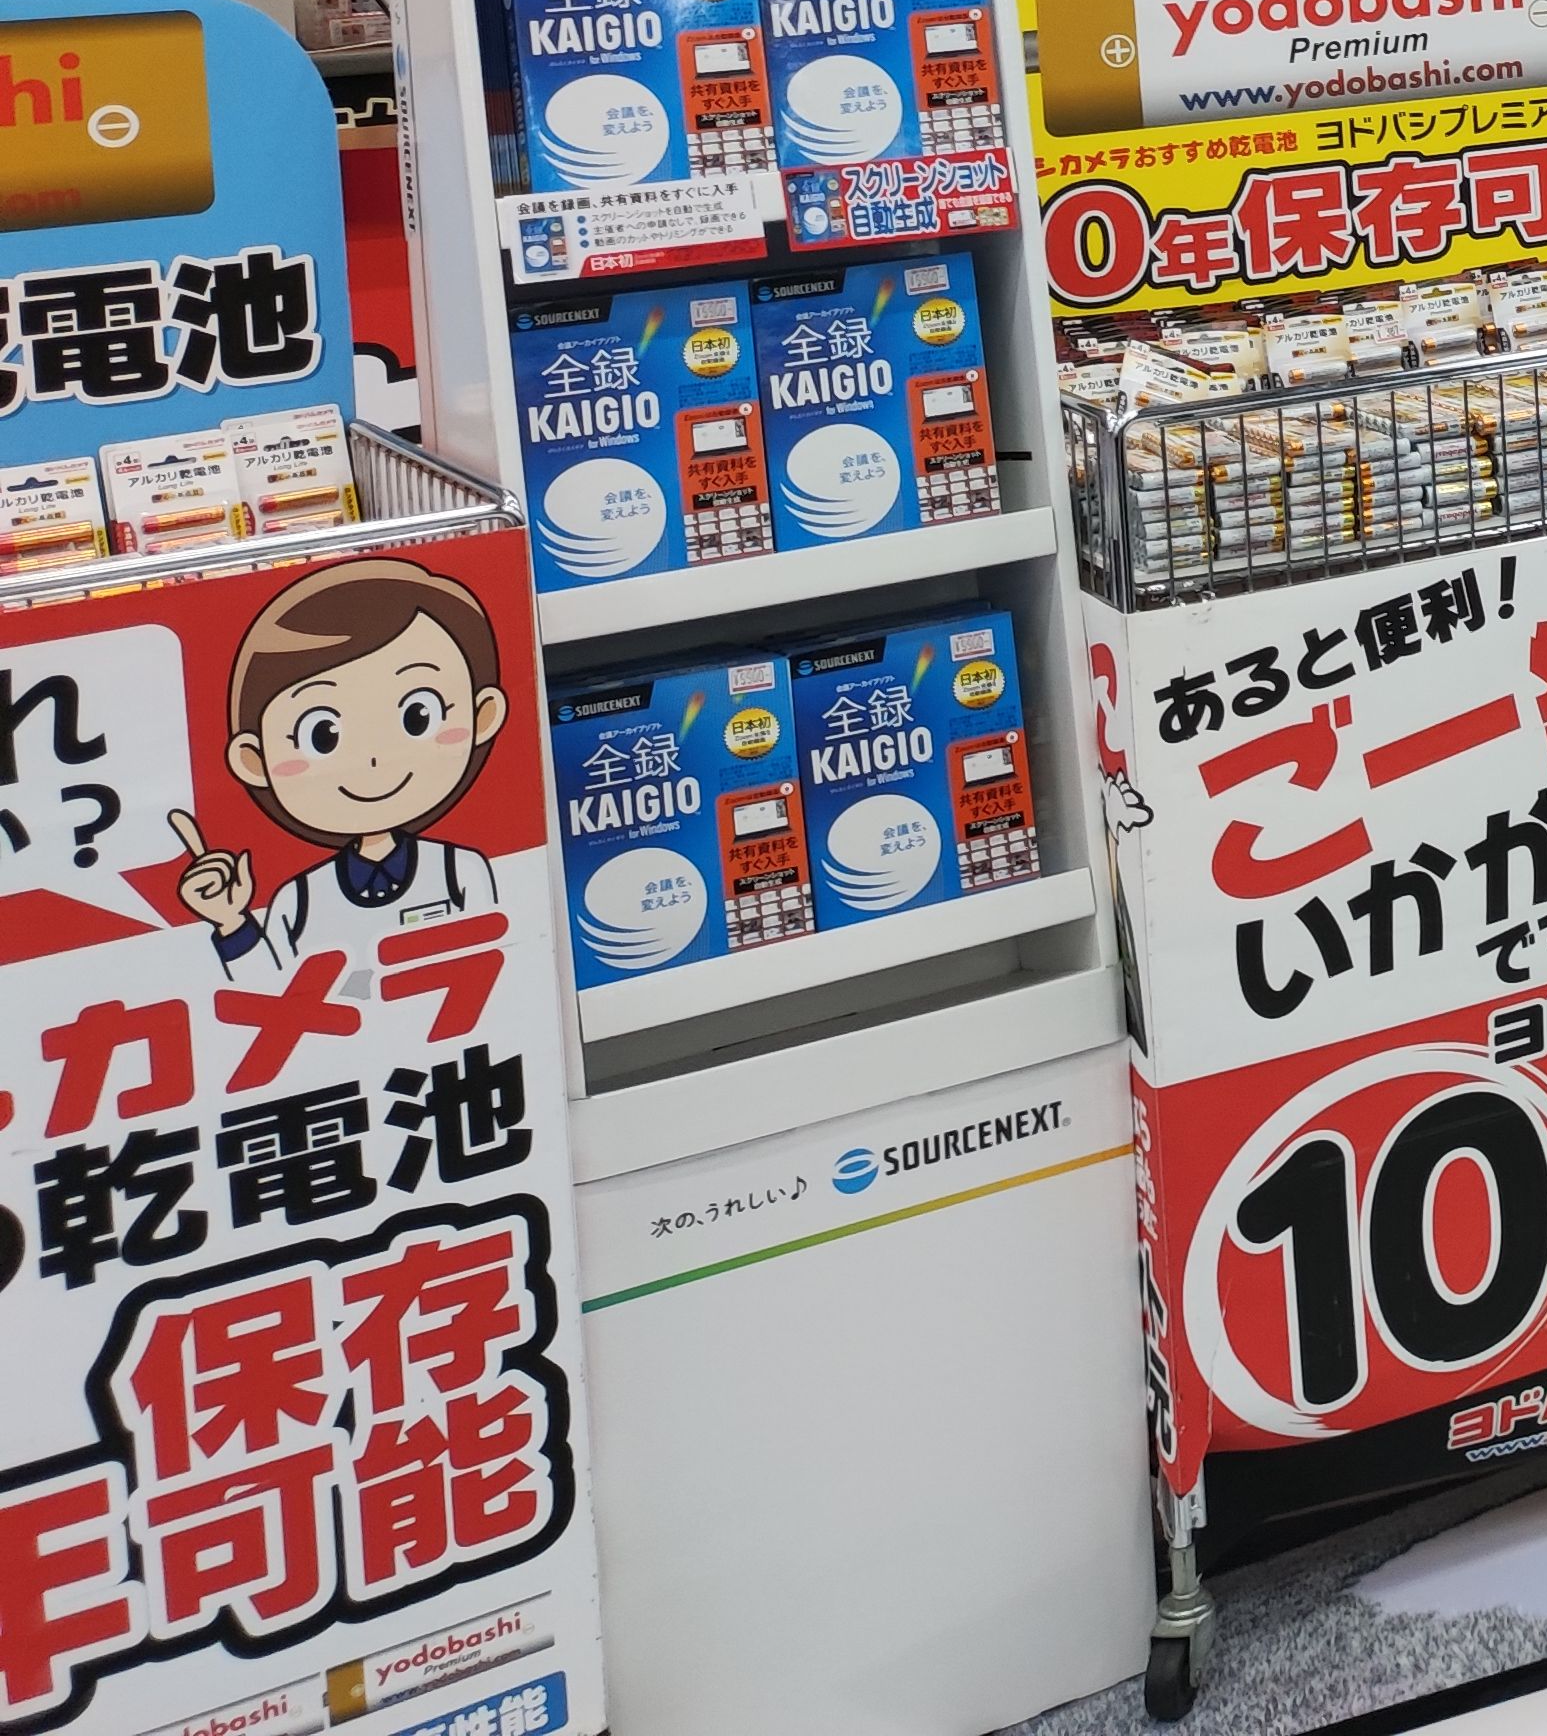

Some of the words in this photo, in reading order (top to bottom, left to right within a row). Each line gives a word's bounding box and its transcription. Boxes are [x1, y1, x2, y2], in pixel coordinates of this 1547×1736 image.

[1289, 26, 1430, 64] Premium
[1179, 55, 1524, 112] www.yodobashi.com
[516, 183, 739, 215] 会議を録画、共有資料をすぐに入手
[845, 162, 1005, 201] スクリーンショット
[848, 198, 938, 237] 自動生成
[590, 254, 634, 271] 日本初
[127, 463, 221, 487] アルカリ乾電池
[243, 444, 333, 468] アルカリ乾電池
[842, 454, 887, 469] 会議を、
[839, 467, 887, 484] 変えよう
[1154, 555, 1517, 745] あると便利!
[821, 689, 913, 741] 全録
[582, 736, 680, 791] 全録
[810, 727, 934, 783] KAIGIO
[568, 778, 701, 836] KAIGIO
[879, 835, 926, 856] 変えよう
[882, 822, 927, 841] 会議を、
[640, 892, 692, 912] 変えよう
[645, 878, 693, 895] 会議を、
[884, 1100, 1063, 1177] SOURCENEXT
[130, 1229, 520, 1477] 保存
